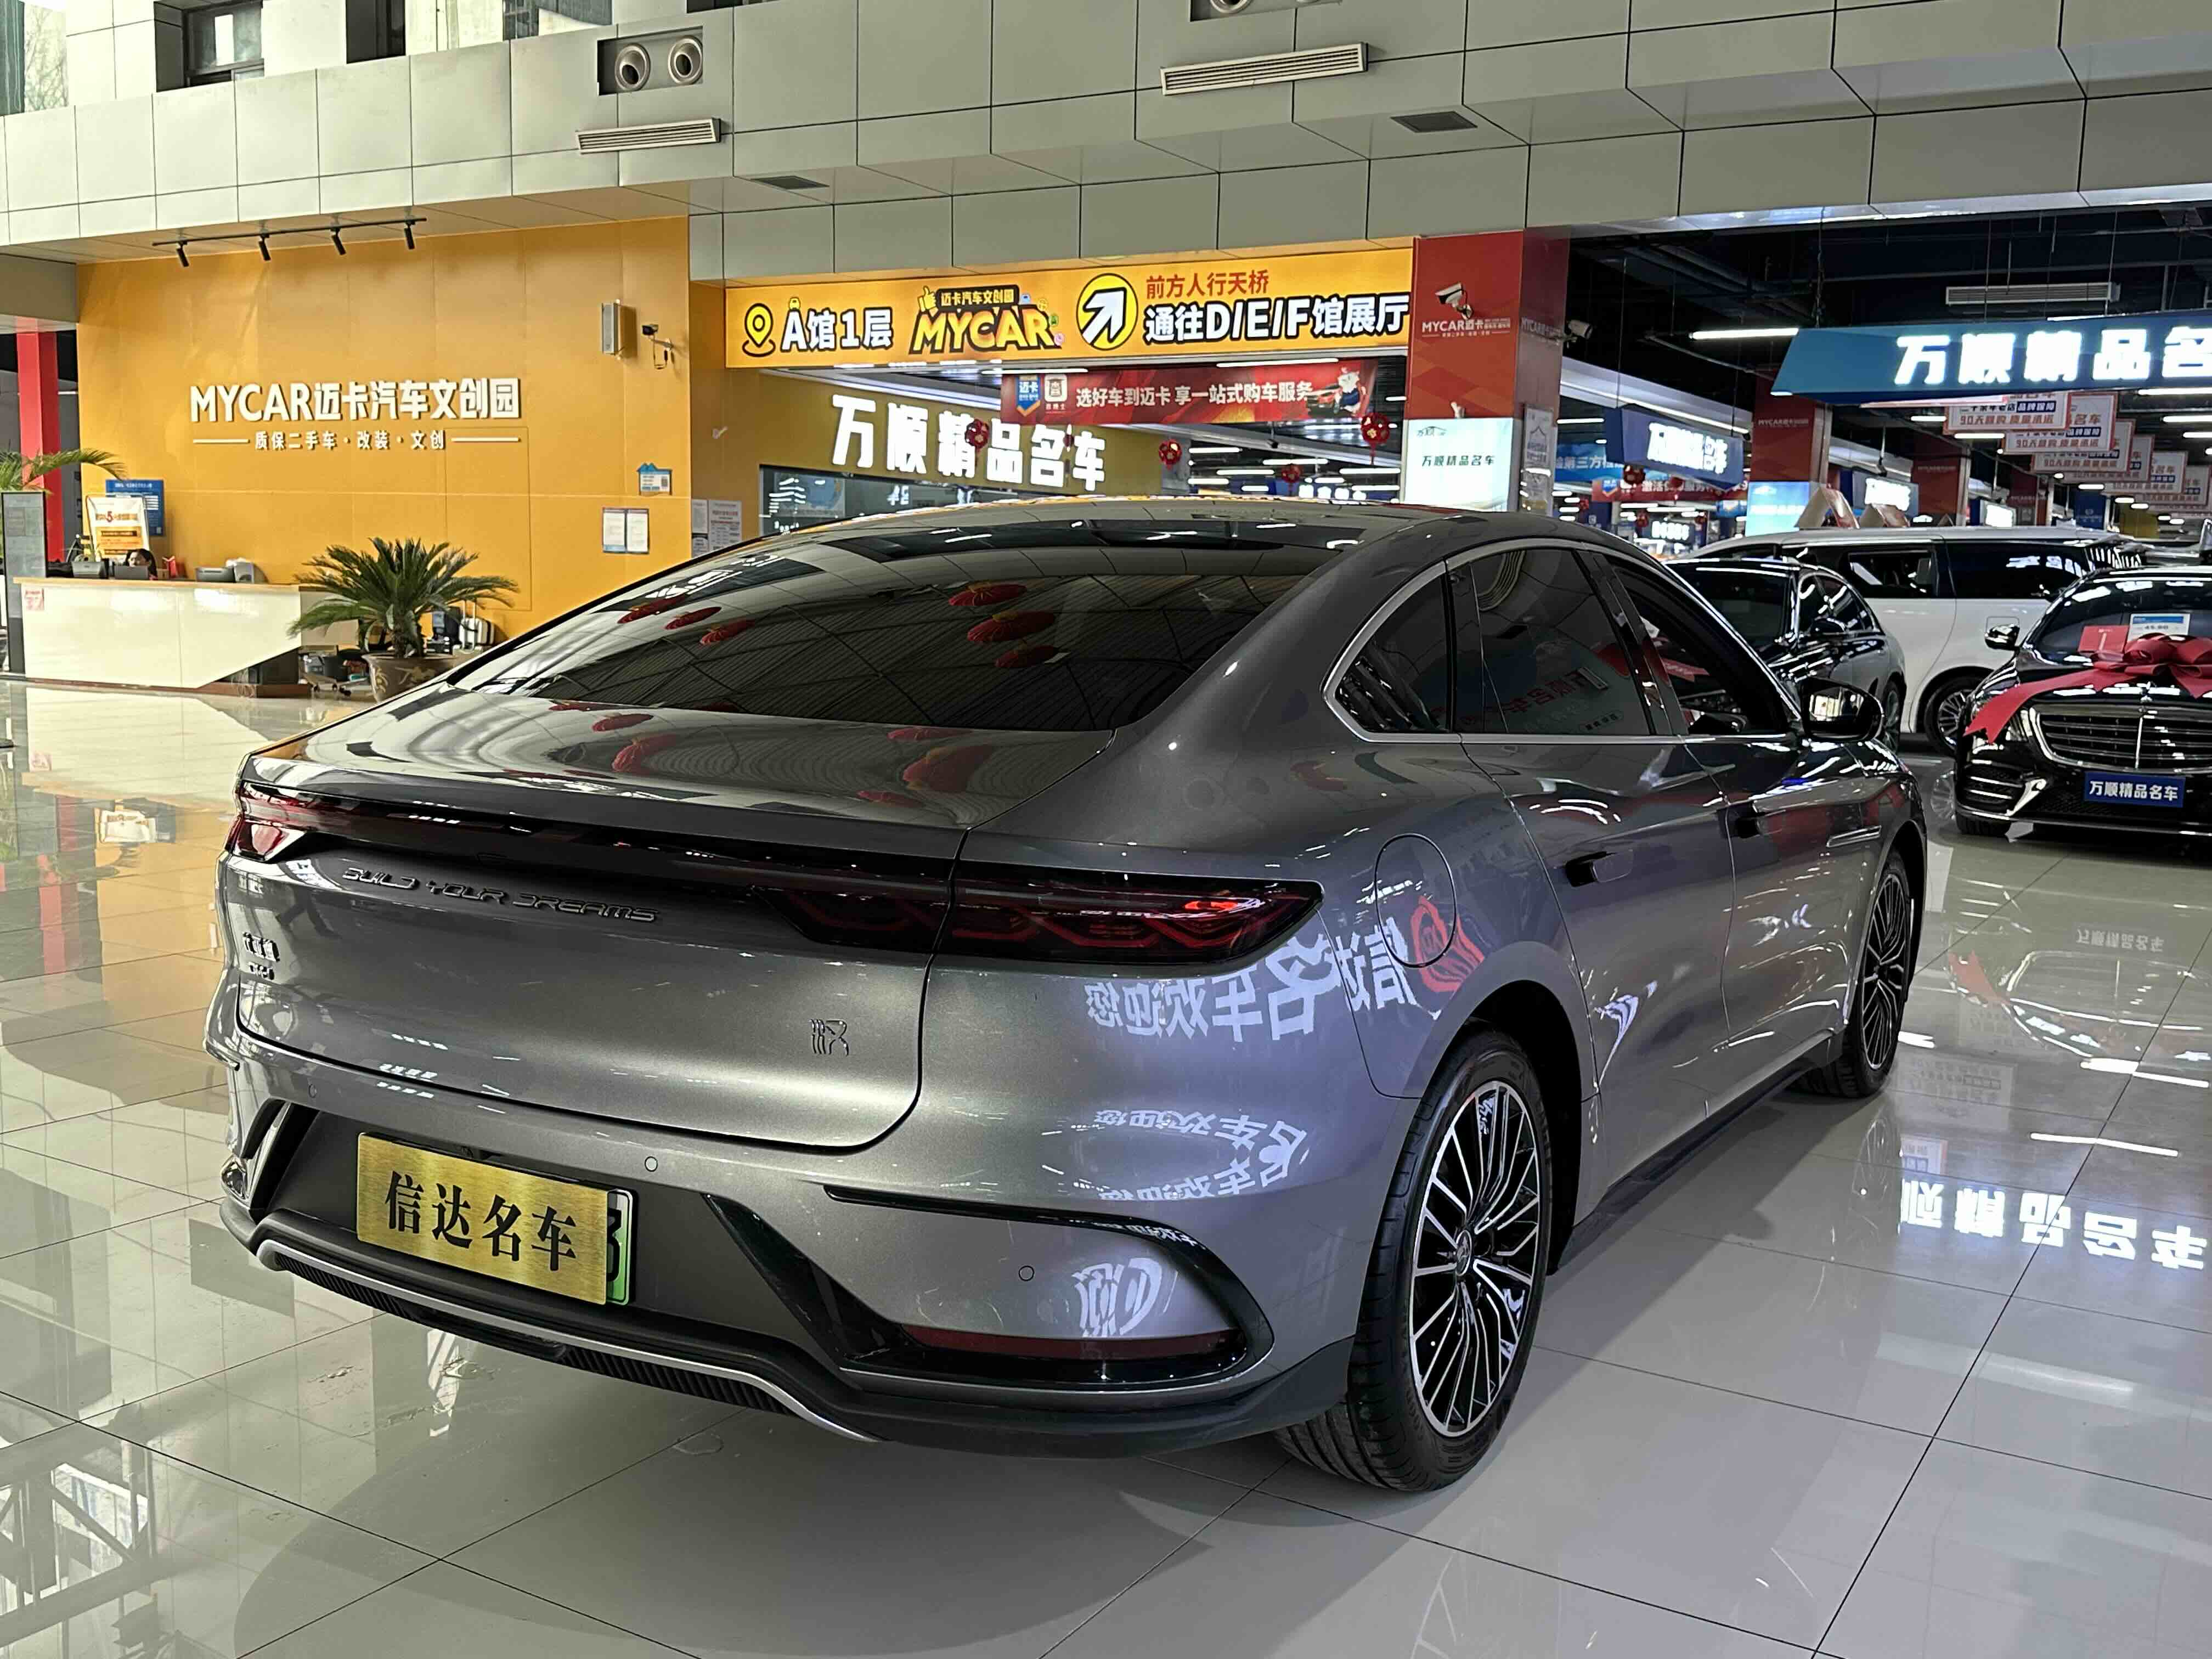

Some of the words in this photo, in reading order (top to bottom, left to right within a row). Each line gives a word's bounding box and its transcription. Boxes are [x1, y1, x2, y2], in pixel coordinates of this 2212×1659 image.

[940, 289, 1014, 306] 迈卡汽车文创园
[1146, 269, 1269, 300] 前方人行天桥
[781, 309, 892, 350] A馆1层
[911, 306, 1059, 353] MYCAR
[1146, 294, 1409, 343] 通往D/E/F馆展厅
[190, 377, 521, 422] MYCAR迈卡汽车文创园
[1076, 385, 1171, 408] 选好车到迈卡
[1175, 380, 1312, 406] 享一站式购车服务
[832, 393, 1106, 492] 万顺精品名车
[1421, 455, 1495, 466] 万顺精品名车
[2089, 780, 2178, 802] 万顺精品名车
[342, 867, 418, 889] BUILD
[426, 880, 506, 905] YOUR
[513, 892, 658, 922] DREAMS
[385, 1170, 577, 1272] 信达名车
